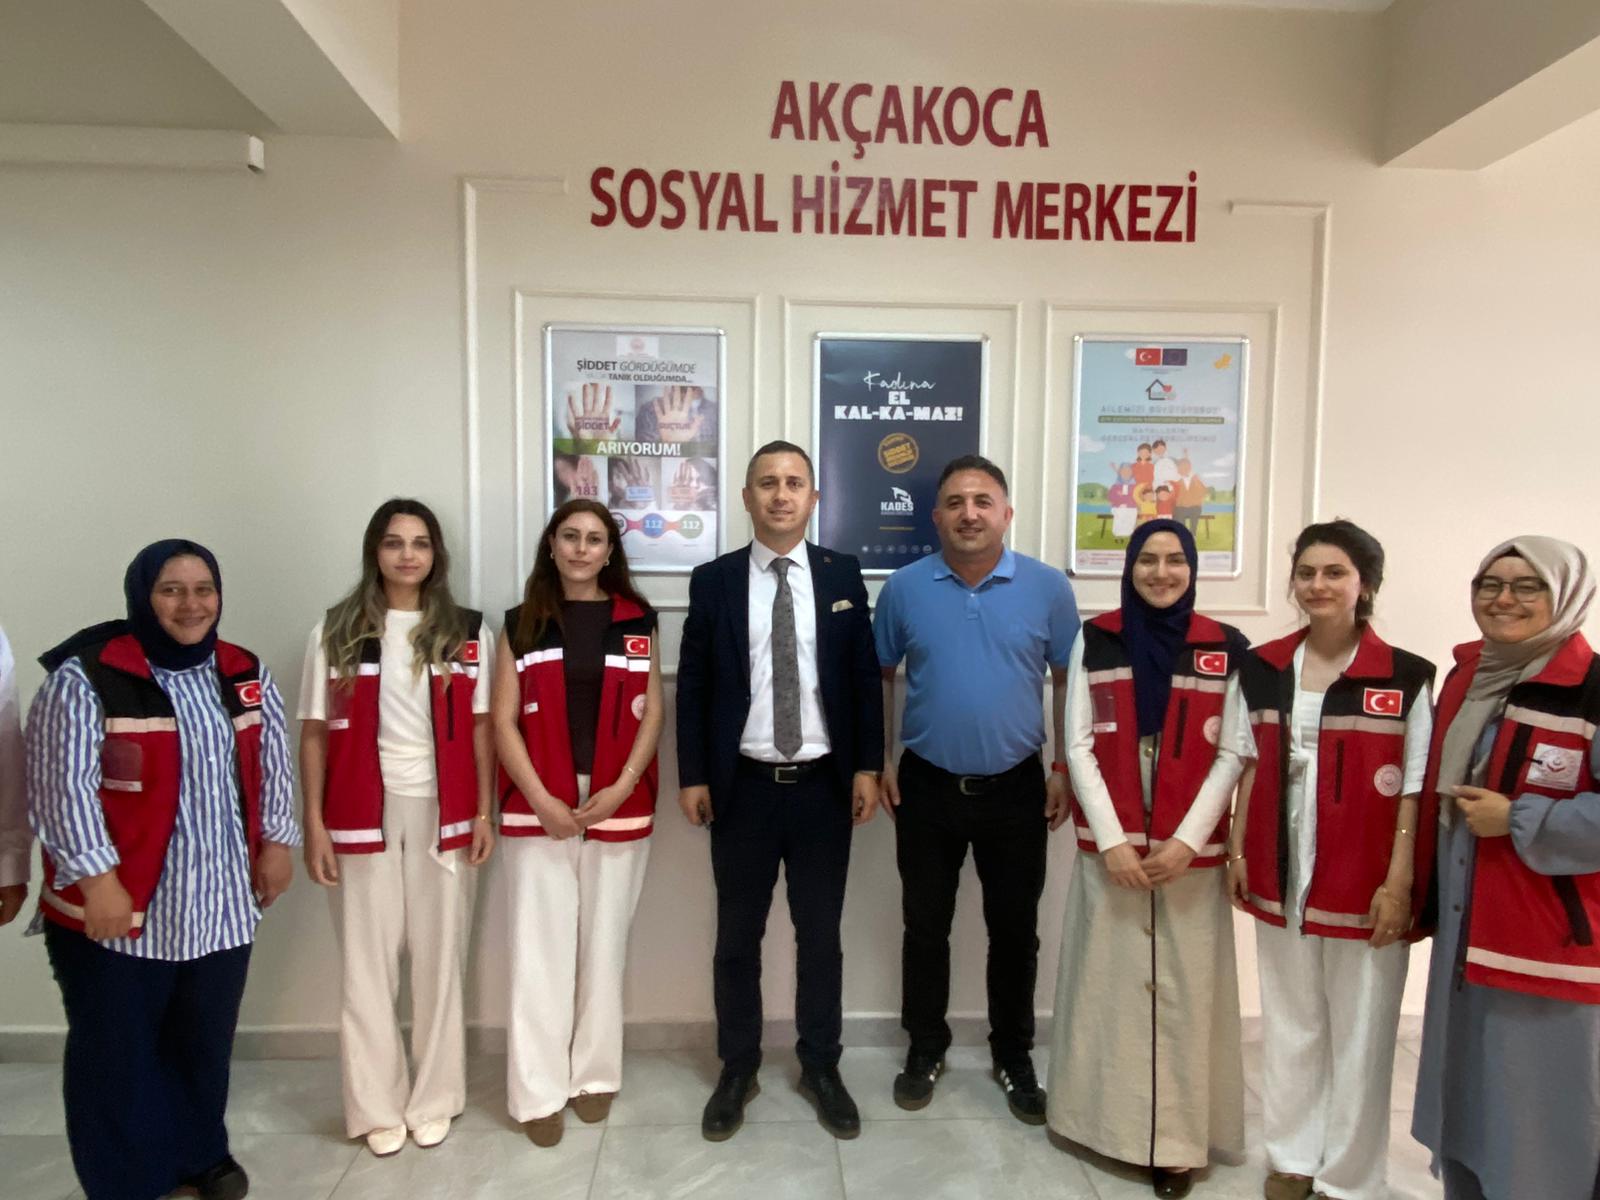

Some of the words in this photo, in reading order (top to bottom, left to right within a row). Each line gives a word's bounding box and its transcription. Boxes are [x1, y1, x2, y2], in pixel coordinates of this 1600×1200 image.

[770, 80, 1049, 159] AKÇAKOCA
[590, 166, 779, 233] SOSYAL
[792, 160, 978, 238] HİZMET
[993, 170, 1198, 242] MERKEZİ
[577, 358, 617, 372] ŞİDDET
[619, 360, 697, 374] GÖRDÜĞÜMDE
[608, 373, 632, 381] TANIK
[888, 391, 911, 405] EL
[834, 405, 964, 421] KAL-KA-MAZ!
[596, 441, 681, 455] ARIYORUM!
[576, 486, 598, 496] 183
[645, 520, 663, 528] 112
[682, 520, 700, 529] 112
